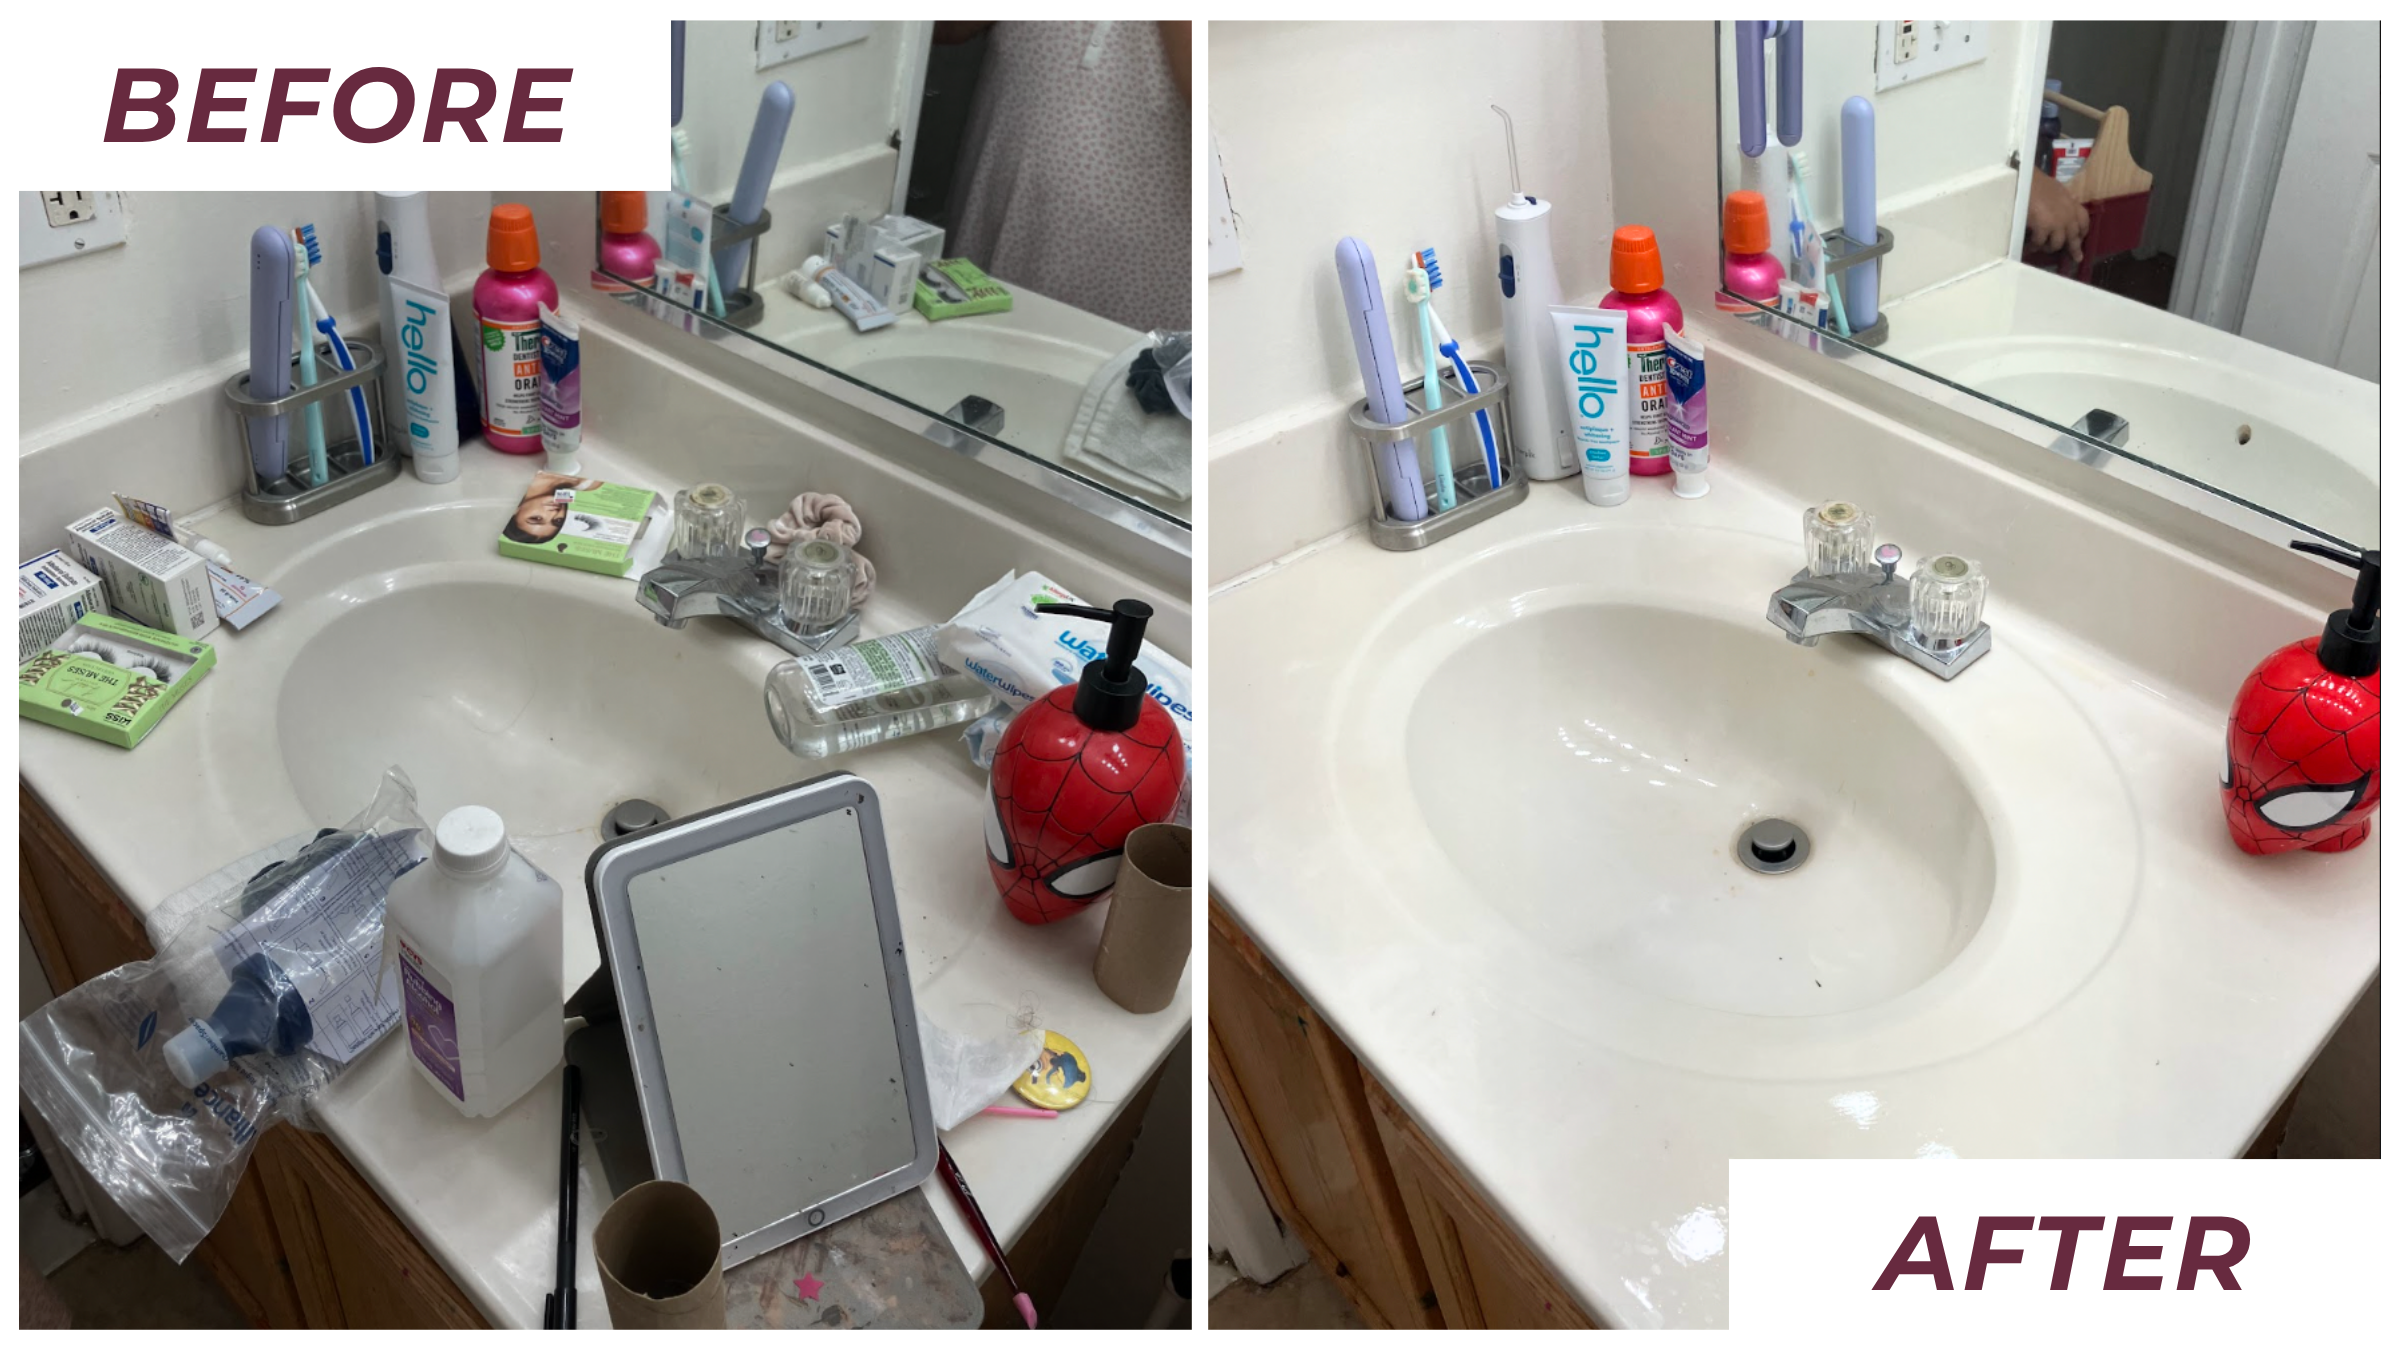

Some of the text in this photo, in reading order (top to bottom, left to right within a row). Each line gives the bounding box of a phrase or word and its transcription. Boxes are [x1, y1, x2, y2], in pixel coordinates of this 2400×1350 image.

[402, 300, 437, 394] hello
[1569, 325, 1618, 418] hello
[67, 665, 119, 686] THE MUSES
[105, 712, 131, 726] KISS
